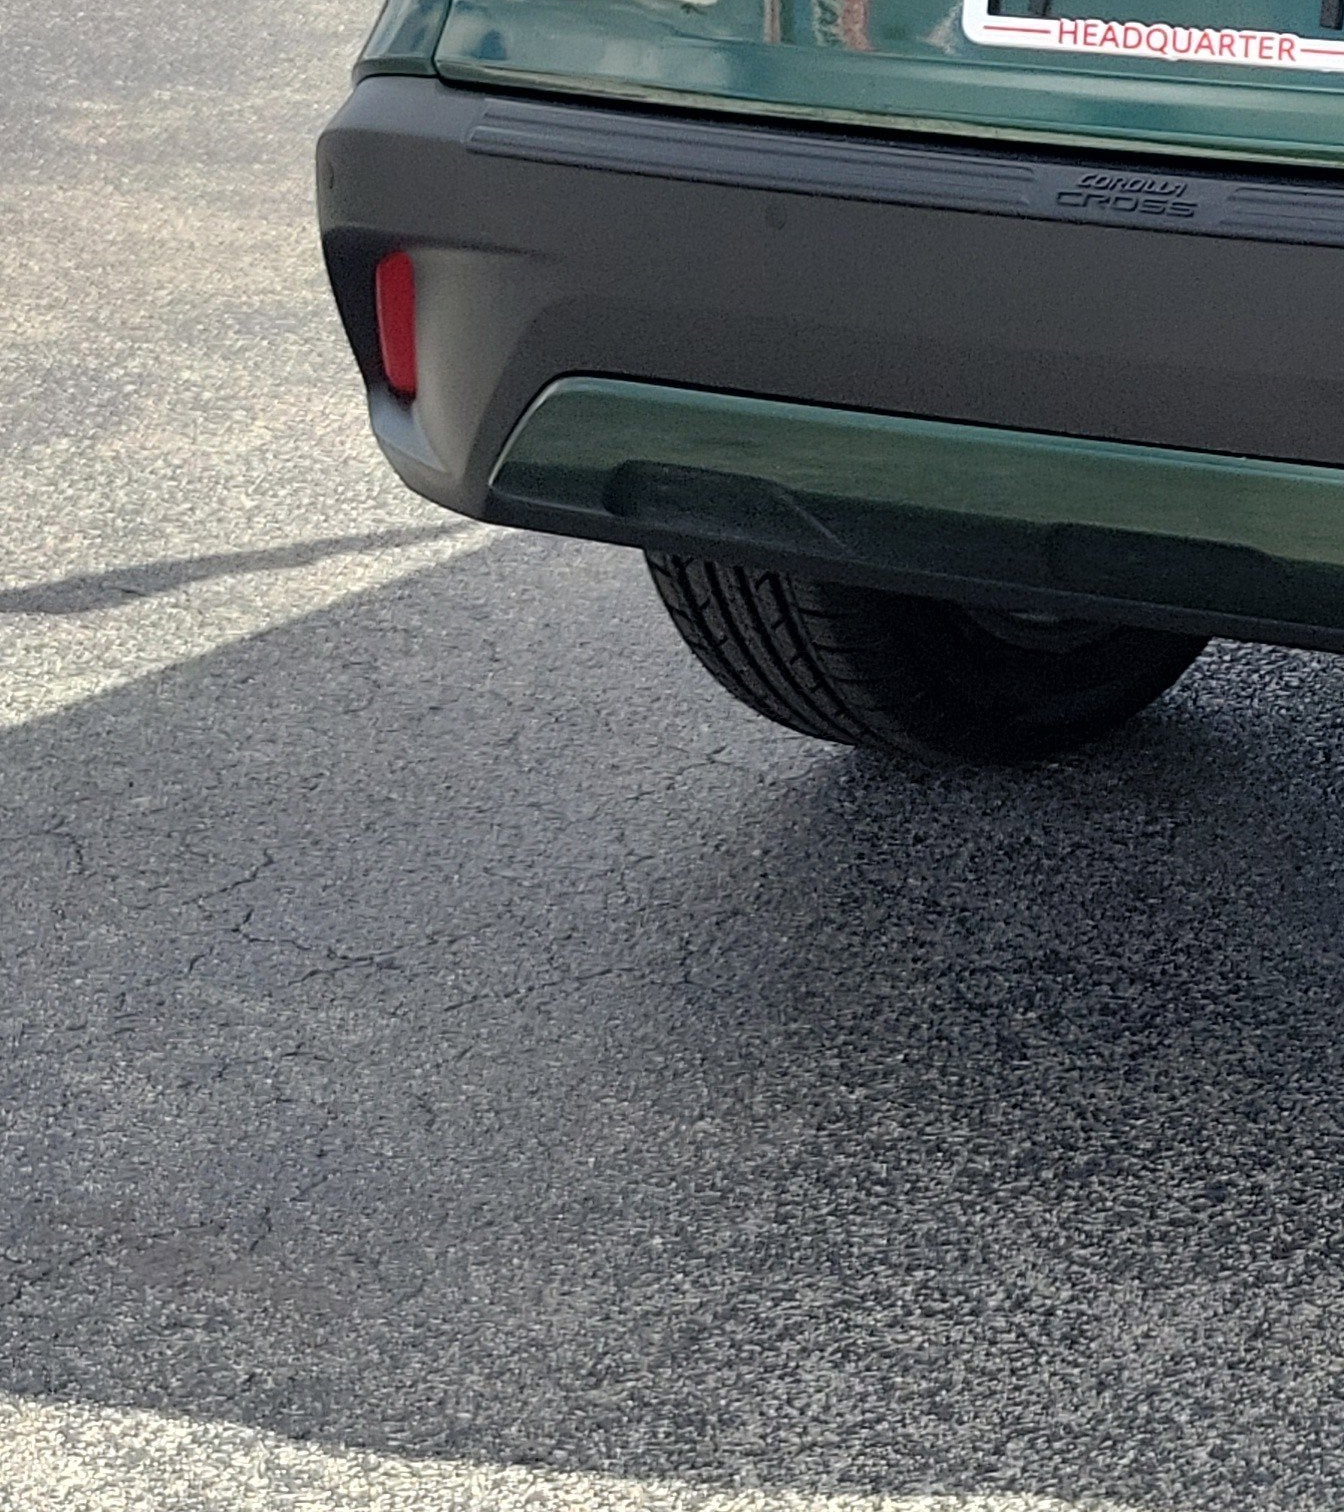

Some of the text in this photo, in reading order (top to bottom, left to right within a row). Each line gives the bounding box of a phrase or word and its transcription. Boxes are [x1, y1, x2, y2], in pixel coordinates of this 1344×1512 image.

[1058, 20, 1297, 62] HEADQUARTER
[1077, 174, 1188, 198] COROLLA
[1055, 191, 1198, 218] CROSS
